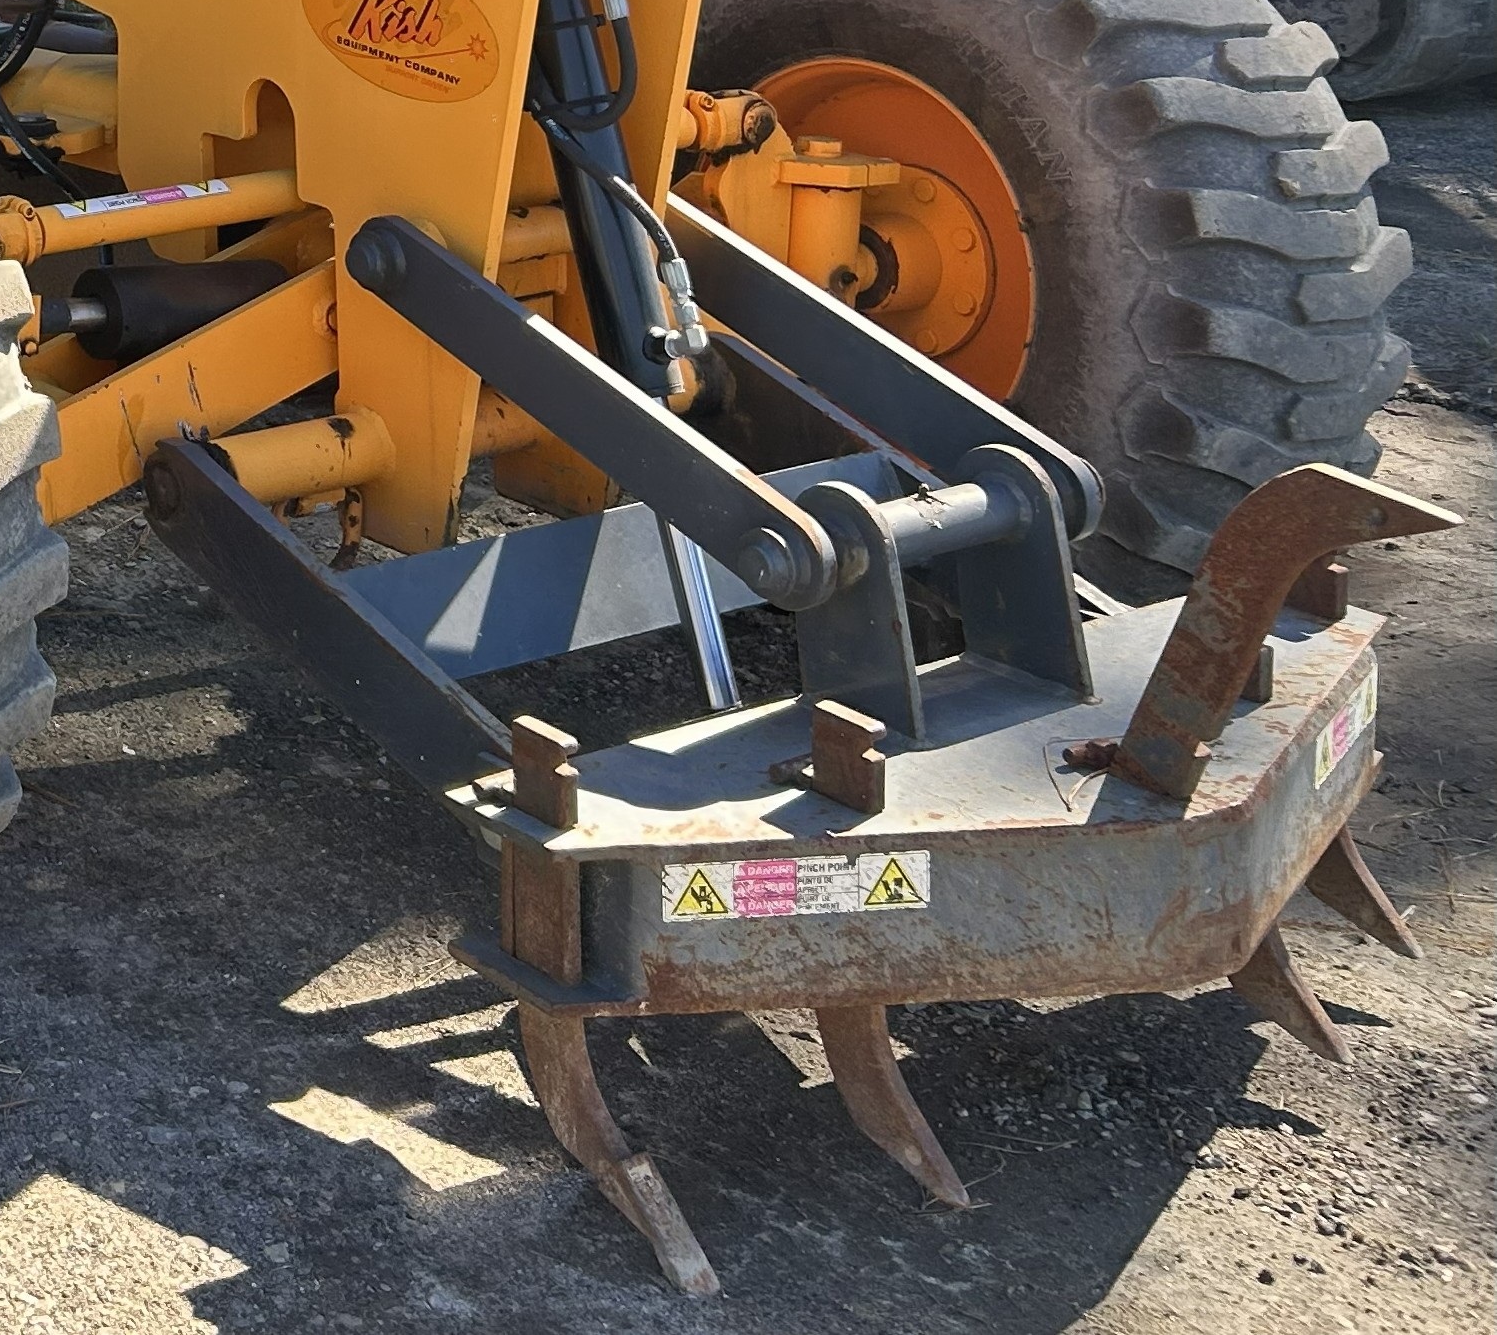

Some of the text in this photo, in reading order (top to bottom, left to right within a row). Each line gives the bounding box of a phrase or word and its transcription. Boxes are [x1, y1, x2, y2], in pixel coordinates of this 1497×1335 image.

[336, 35, 461, 86] EQUIPMENT COMPANY
[747, 864, 794, 876] DANGER
[797, 863, 826, 874] PINCH
[745, 881, 795, 894] PELGRO
